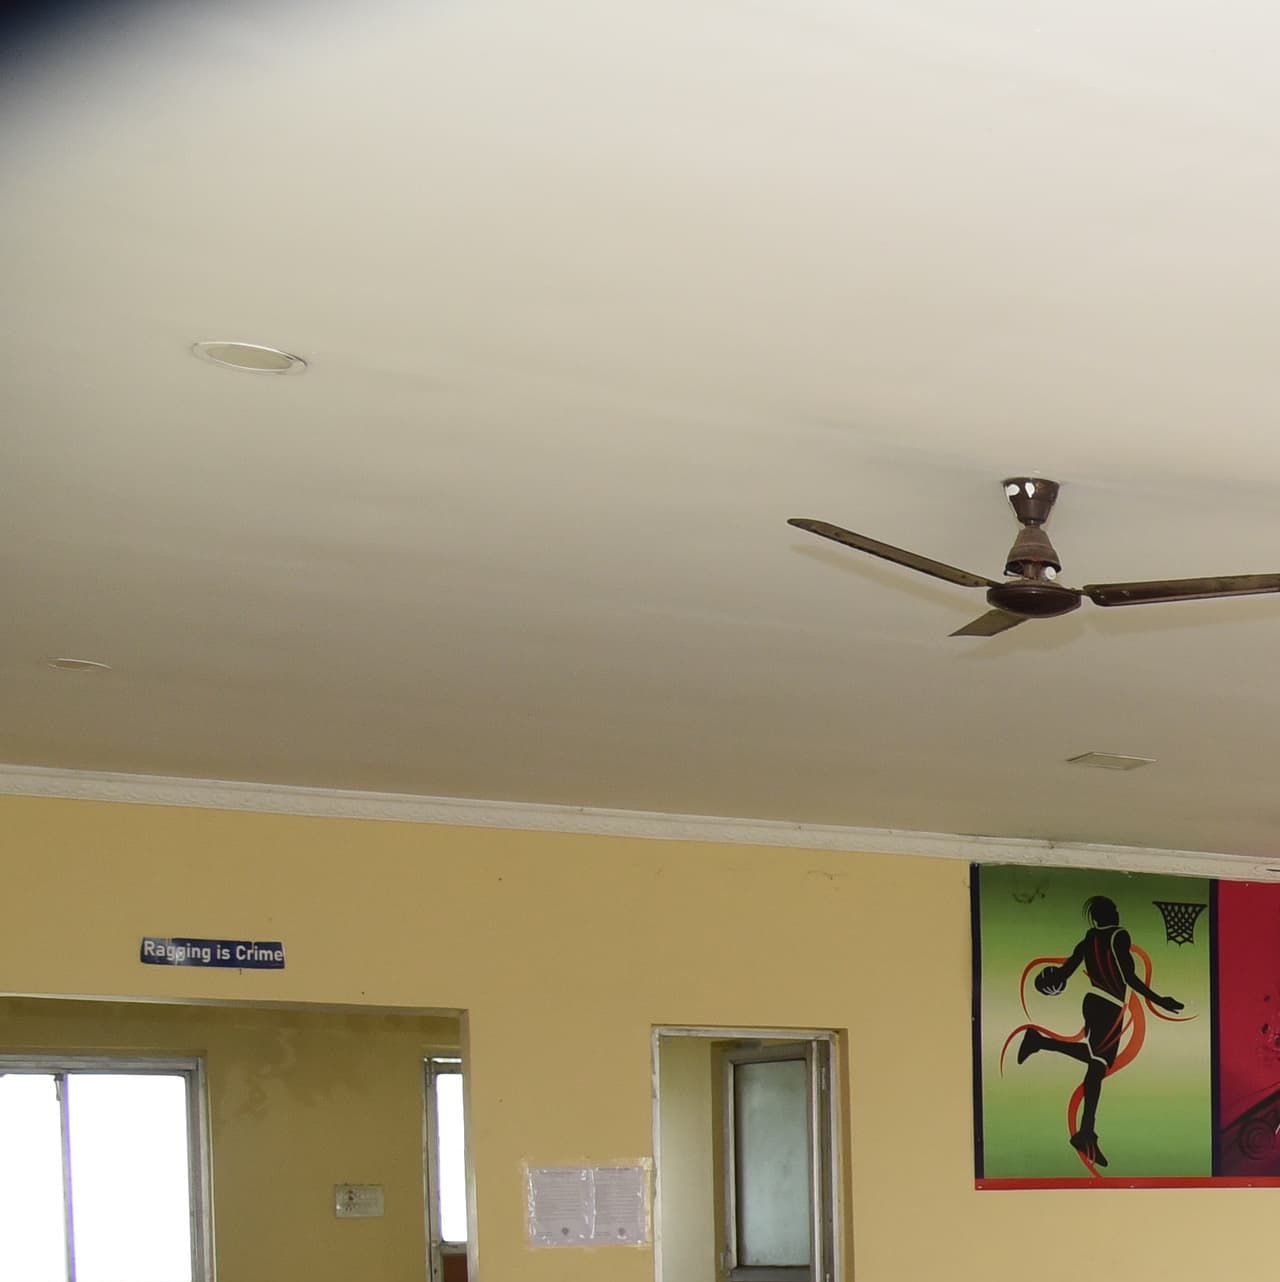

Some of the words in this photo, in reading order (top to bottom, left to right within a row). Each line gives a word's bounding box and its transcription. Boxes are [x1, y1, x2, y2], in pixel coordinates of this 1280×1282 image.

[143, 940, 211, 962] Ragging
[216, 945, 231, 959] is
[236, 945, 283, 961] Crime
